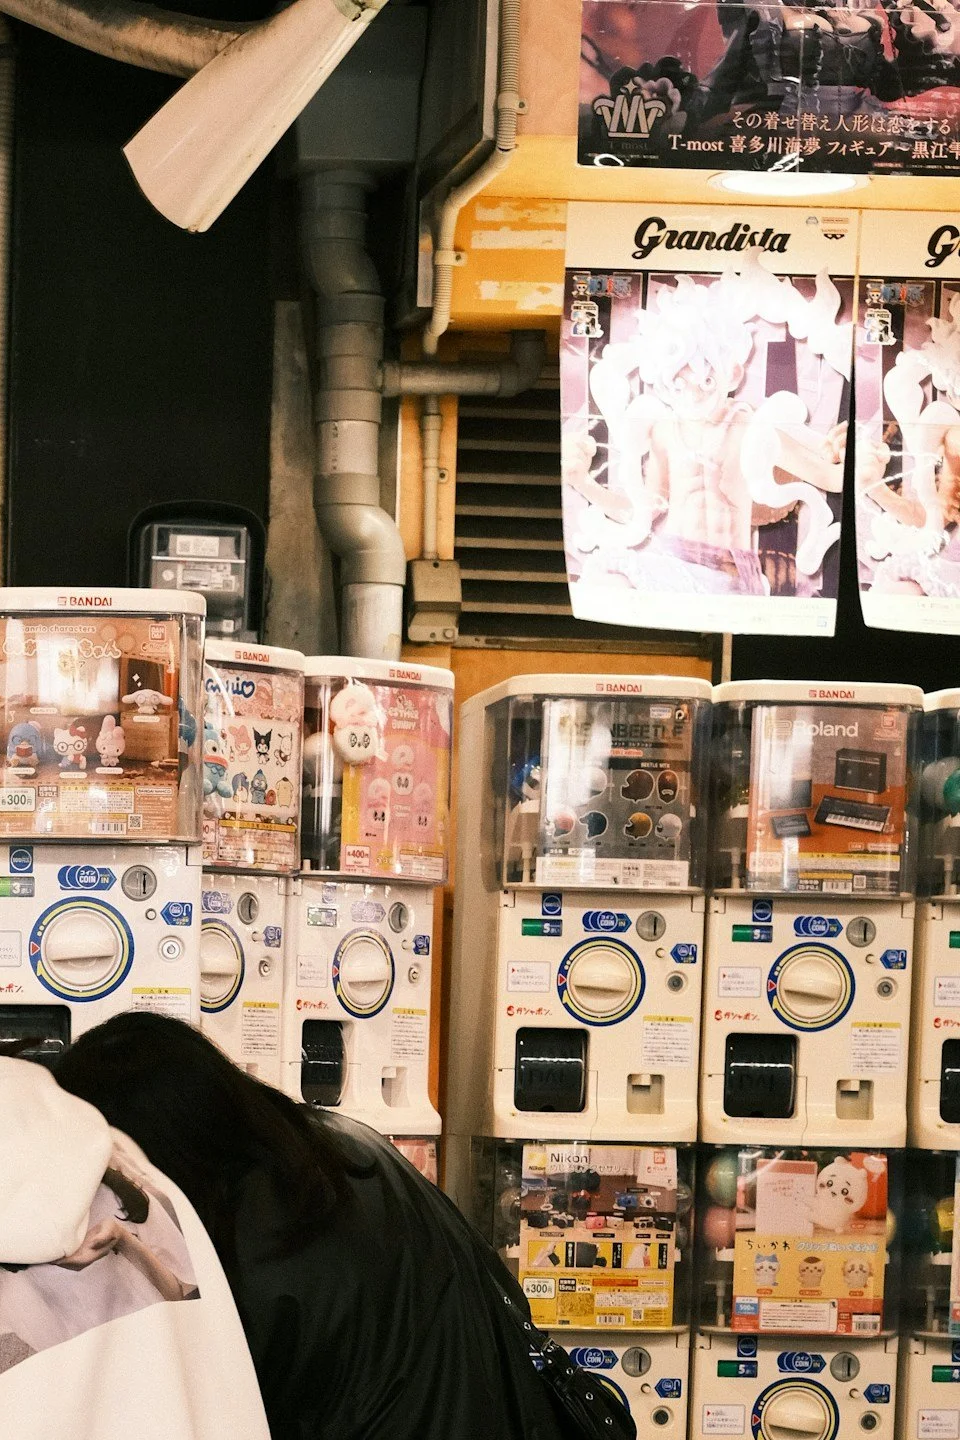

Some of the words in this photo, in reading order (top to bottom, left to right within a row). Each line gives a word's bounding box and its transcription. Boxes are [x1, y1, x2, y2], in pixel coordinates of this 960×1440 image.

[732, 111, 952, 135] その着せ替え人形は恋をする
[668, 133, 724, 152] T-most
[729, 135, 821, 155] 喜多川海夢
[631, 216, 792, 260] Grandista
[69, 596, 113, 607] BANDAI
[48, 624, 96, 634] characters
[242, 651, 270, 663] BANDAI
[396, 669, 422, 681] BANDAI
[606, 683, 643, 693] BANDAI
[819, 689, 856, 699] BANDAI
[792, 721, 859, 738] Roland
[79, 875, 97, 884] COIN
[600, 919, 615, 927] COIN
[550, 1152, 589, 1163] Nikon
[745, 1239, 791, 1252] ちいかわ
